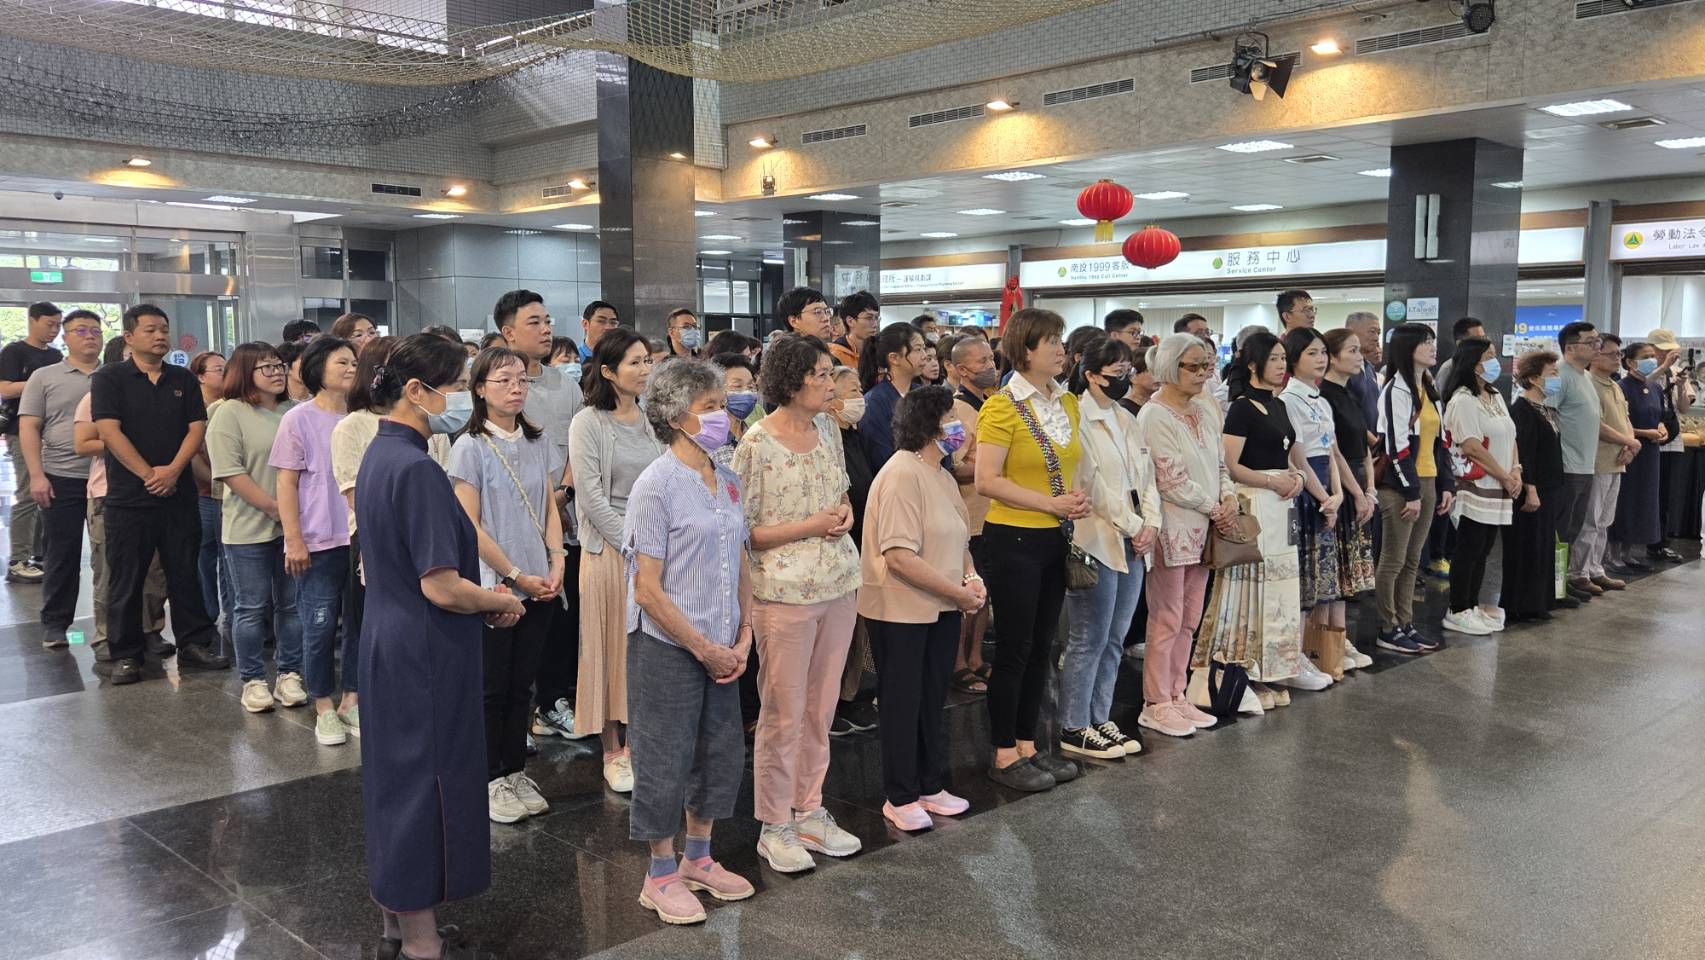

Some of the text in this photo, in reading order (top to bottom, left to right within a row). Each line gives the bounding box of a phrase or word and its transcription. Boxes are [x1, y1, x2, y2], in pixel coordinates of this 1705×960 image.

[1227, 248, 1301, 266] 服務中心
[1070, 260, 1134, 272] 南投1999客服
